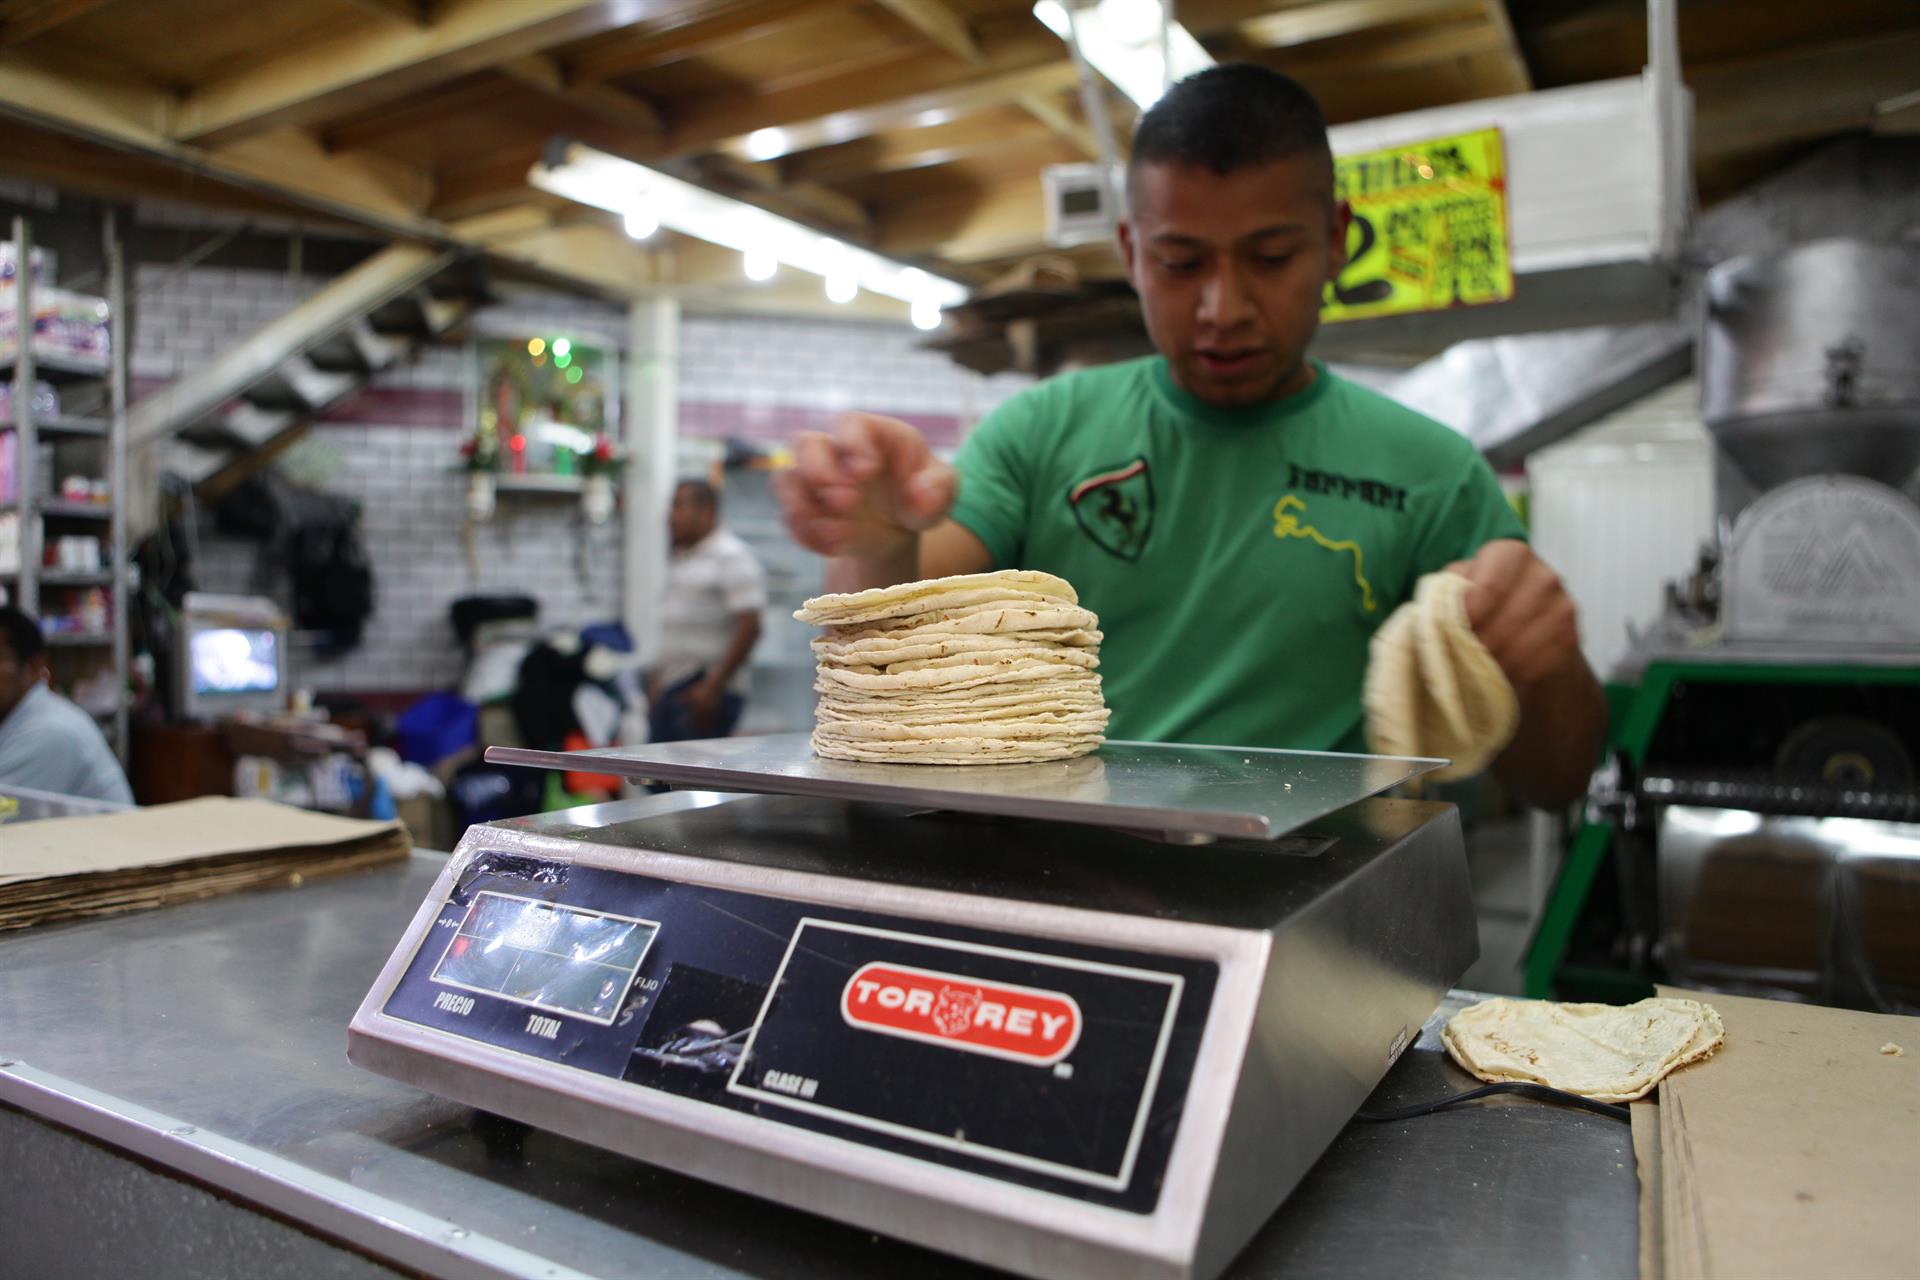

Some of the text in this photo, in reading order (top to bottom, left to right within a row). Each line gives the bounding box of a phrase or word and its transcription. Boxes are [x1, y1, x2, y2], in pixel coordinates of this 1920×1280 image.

[634, 976, 659, 990] FIJO
[433, 991, 475, 1016] PRECIO
[525, 1014, 562, 1039] TOTAL
